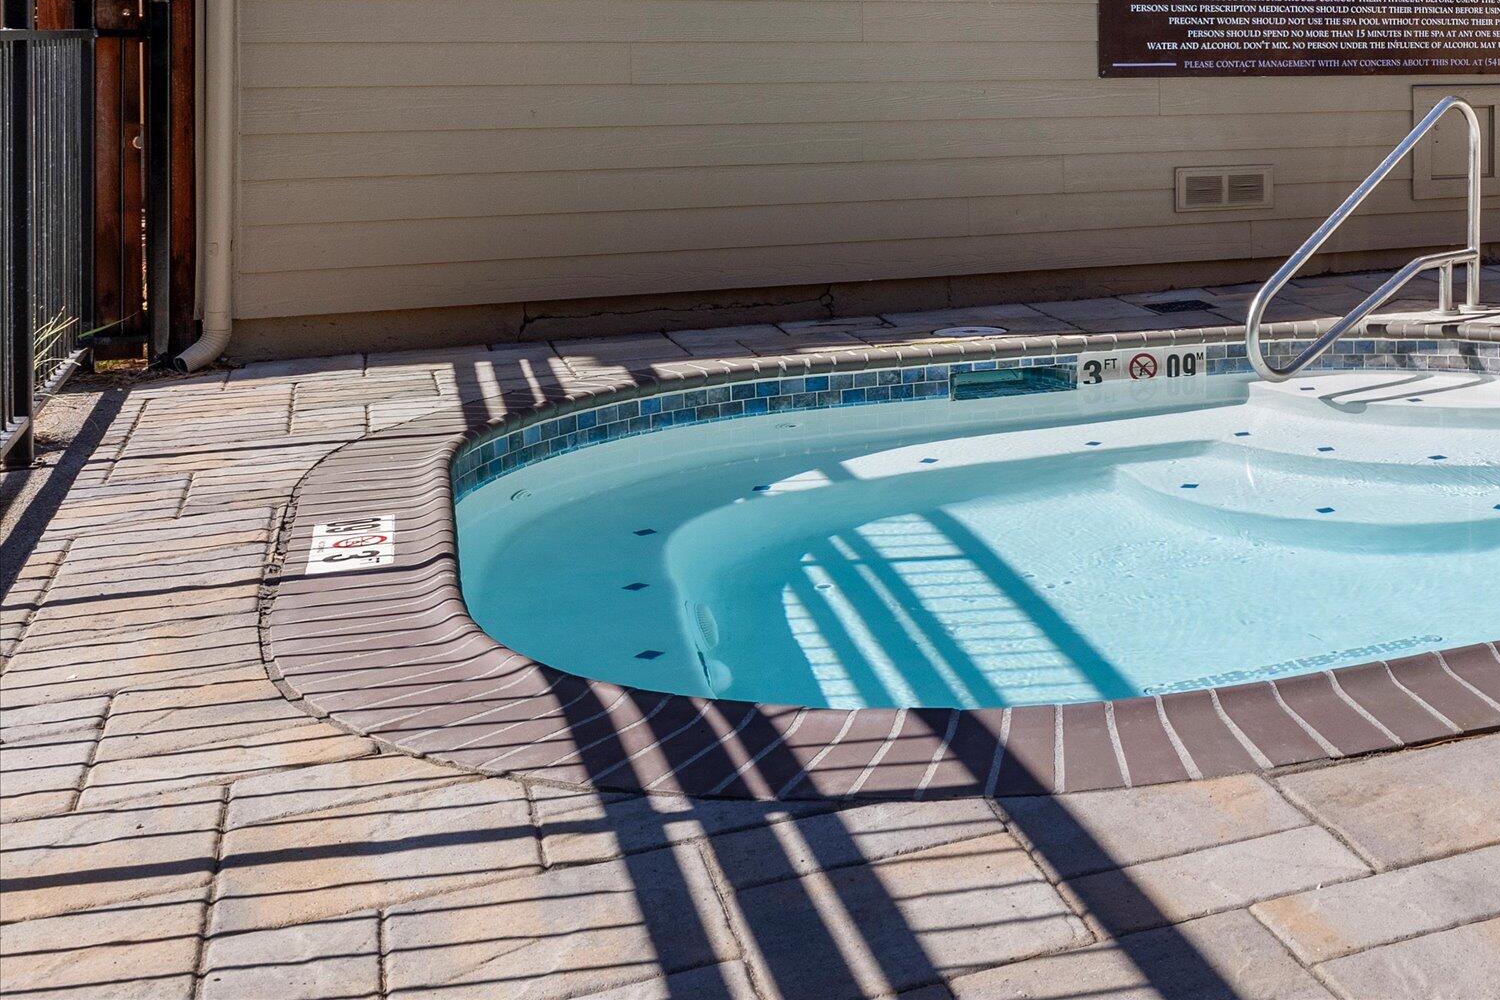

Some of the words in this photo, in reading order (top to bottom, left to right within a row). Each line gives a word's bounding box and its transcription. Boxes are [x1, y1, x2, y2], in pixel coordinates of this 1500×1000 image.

[1216, 60, 1254, 68] CONTACT
[1258, 60, 1314, 68] MANAGEMENT
[1359, 59, 1400, 67] CONCERNS
[1402, 59, 1428, 67] ABOUT
[1431, 59, 1448, 67] THIS
[1472, 58, 1482, 66] AT
[1083, 359, 1103, 384] 3
[1104, 358, 1118, 370] FT
[1196, 352, 1204, 360] M
